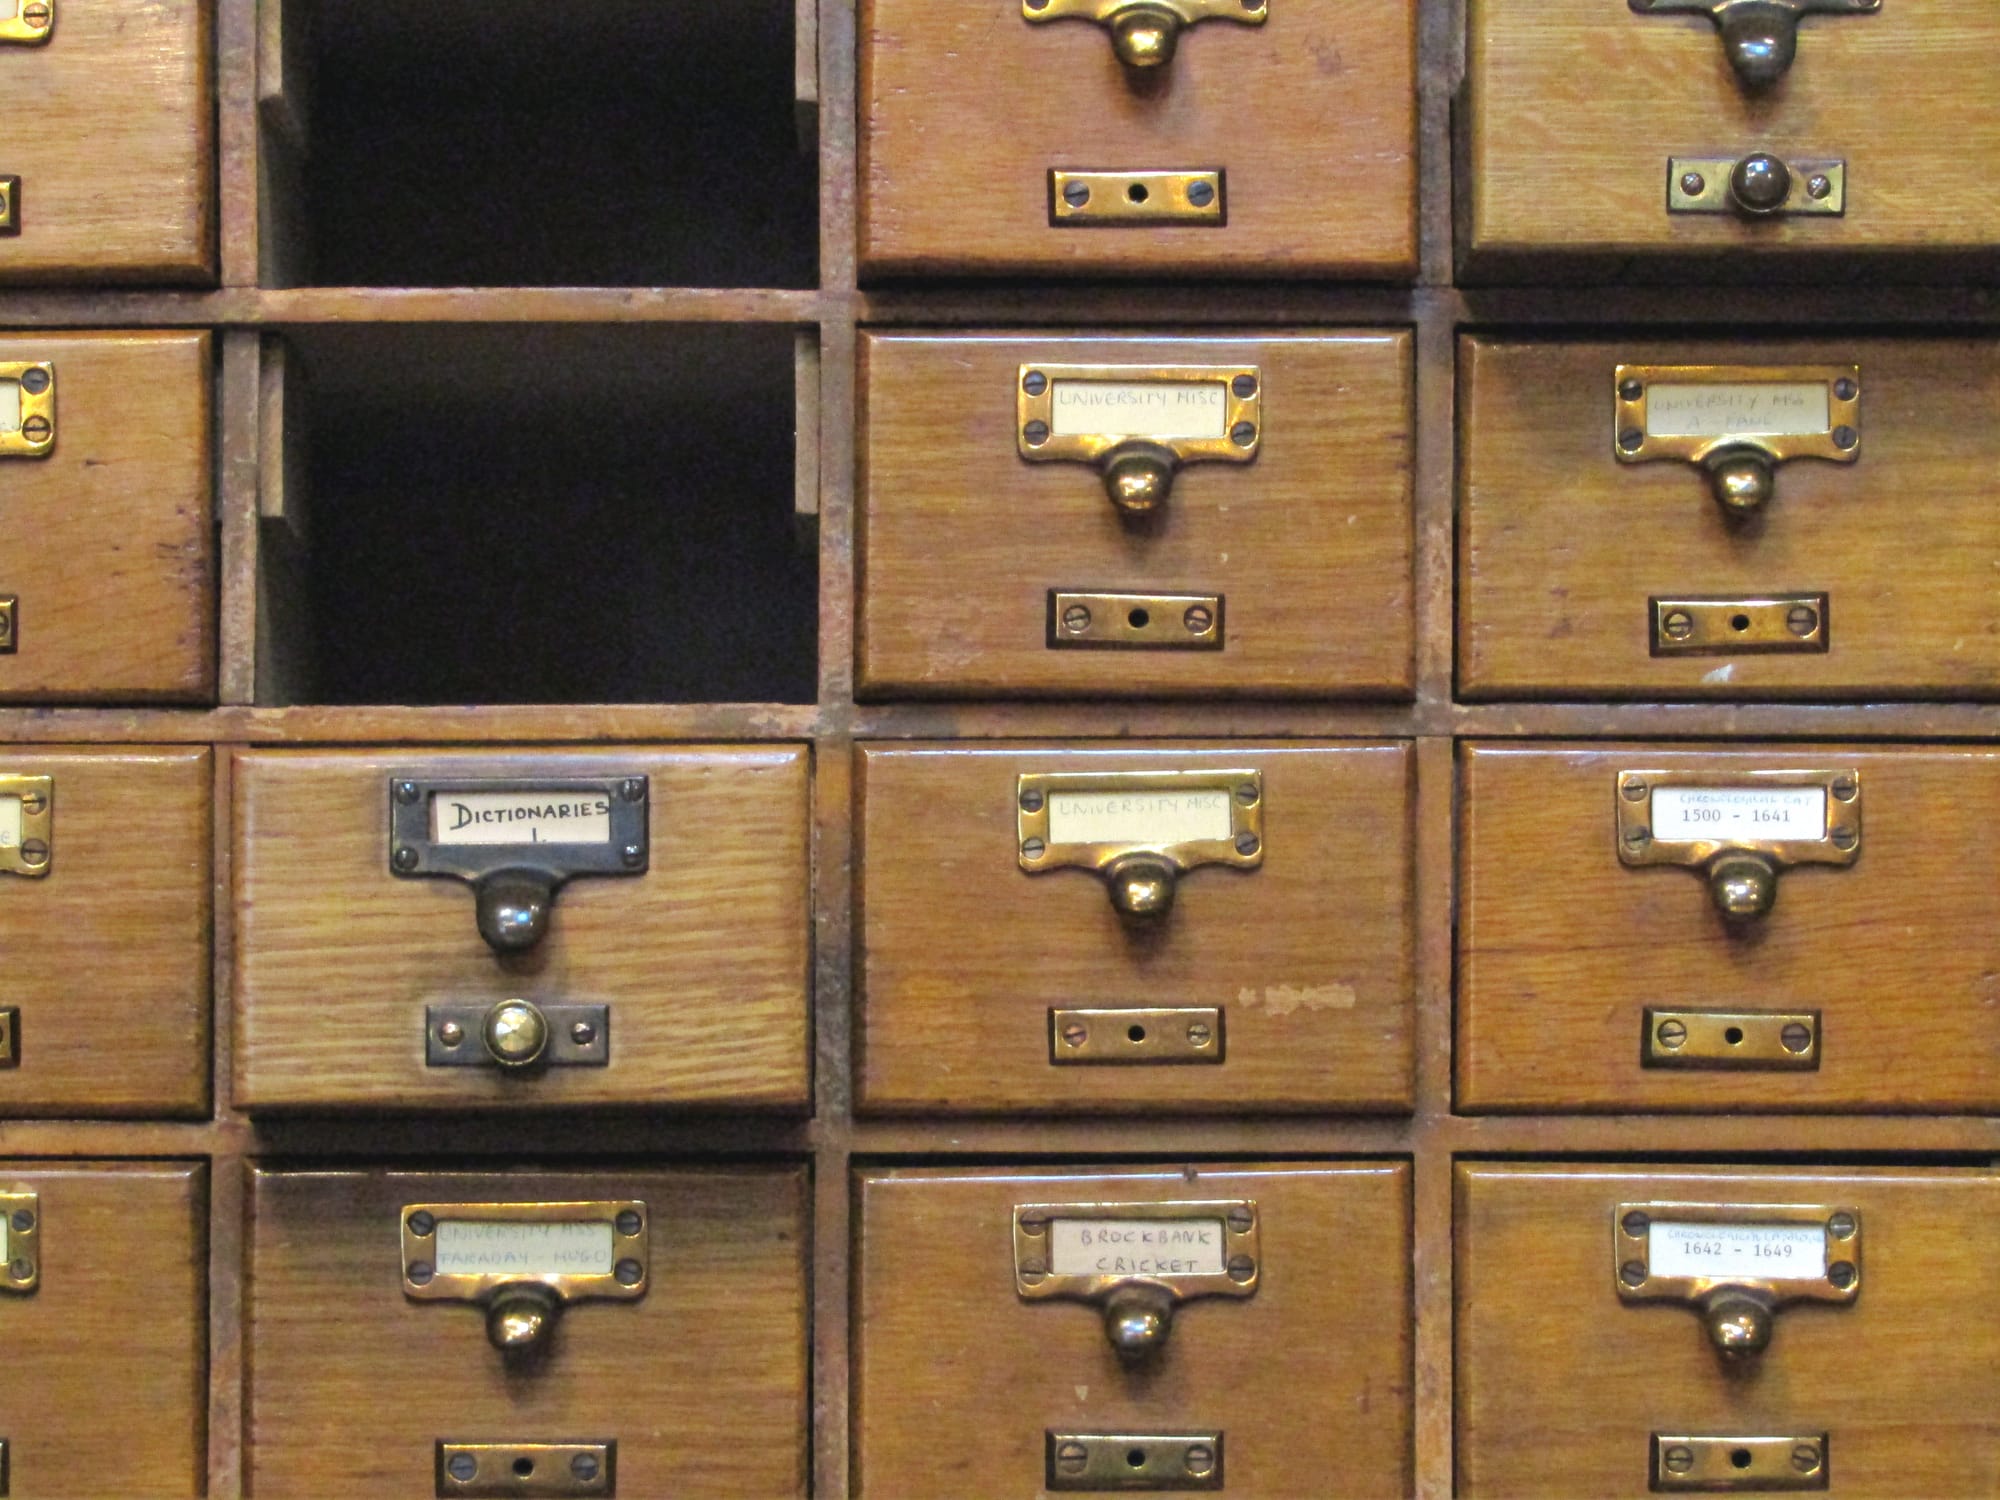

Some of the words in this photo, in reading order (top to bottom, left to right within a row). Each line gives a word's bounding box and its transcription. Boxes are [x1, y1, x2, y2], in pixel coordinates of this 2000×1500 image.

[1059, 390, 1167, 408] UNIVERSITY
[449, 800, 610, 831] DICTIONARIES
[1059, 799, 1178, 816] UNIVERSITY
[1682, 808, 1721, 823] 1500
[1752, 808, 1791, 823] 1641
[1080, 1228, 1212, 1246] BROCKBANK
[1684, 1241, 1722, 1255] 1642
[1754, 1243, 1793, 1258] 1649
[1096, 1257, 1200, 1273] CRICKET
